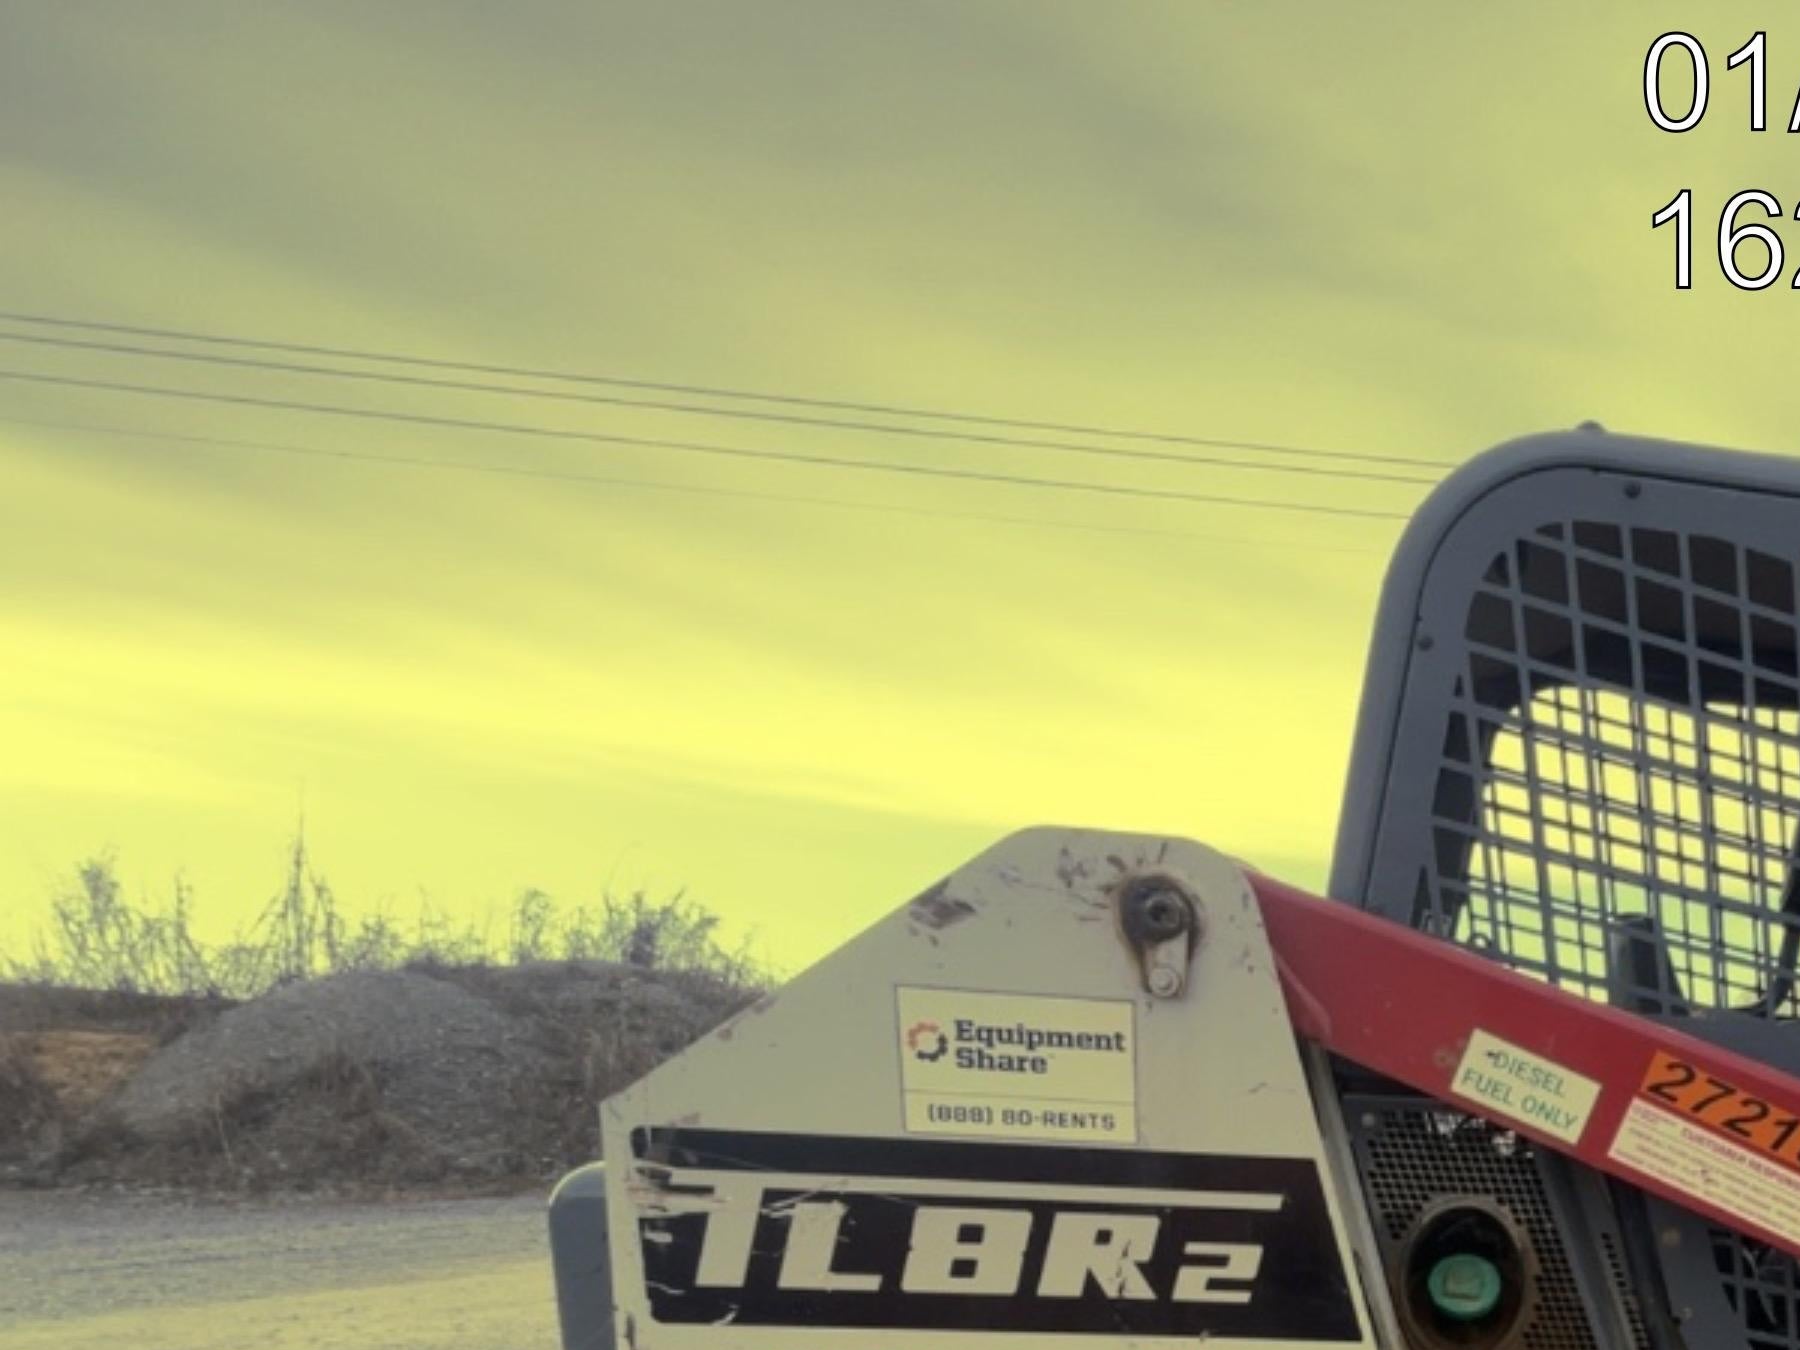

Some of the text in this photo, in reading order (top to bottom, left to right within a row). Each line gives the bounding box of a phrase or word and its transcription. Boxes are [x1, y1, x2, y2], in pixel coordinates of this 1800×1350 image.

[953, 1018, 1127, 1052] Equipment
[955, 1046, 1049, 1074] Share
[1493, 1050, 1565, 1098] DIESEL
[1461, 1067, 1579, 1129] FUEL ONLY
[927, 1103, 1117, 1132] (888) 80-RENTS
